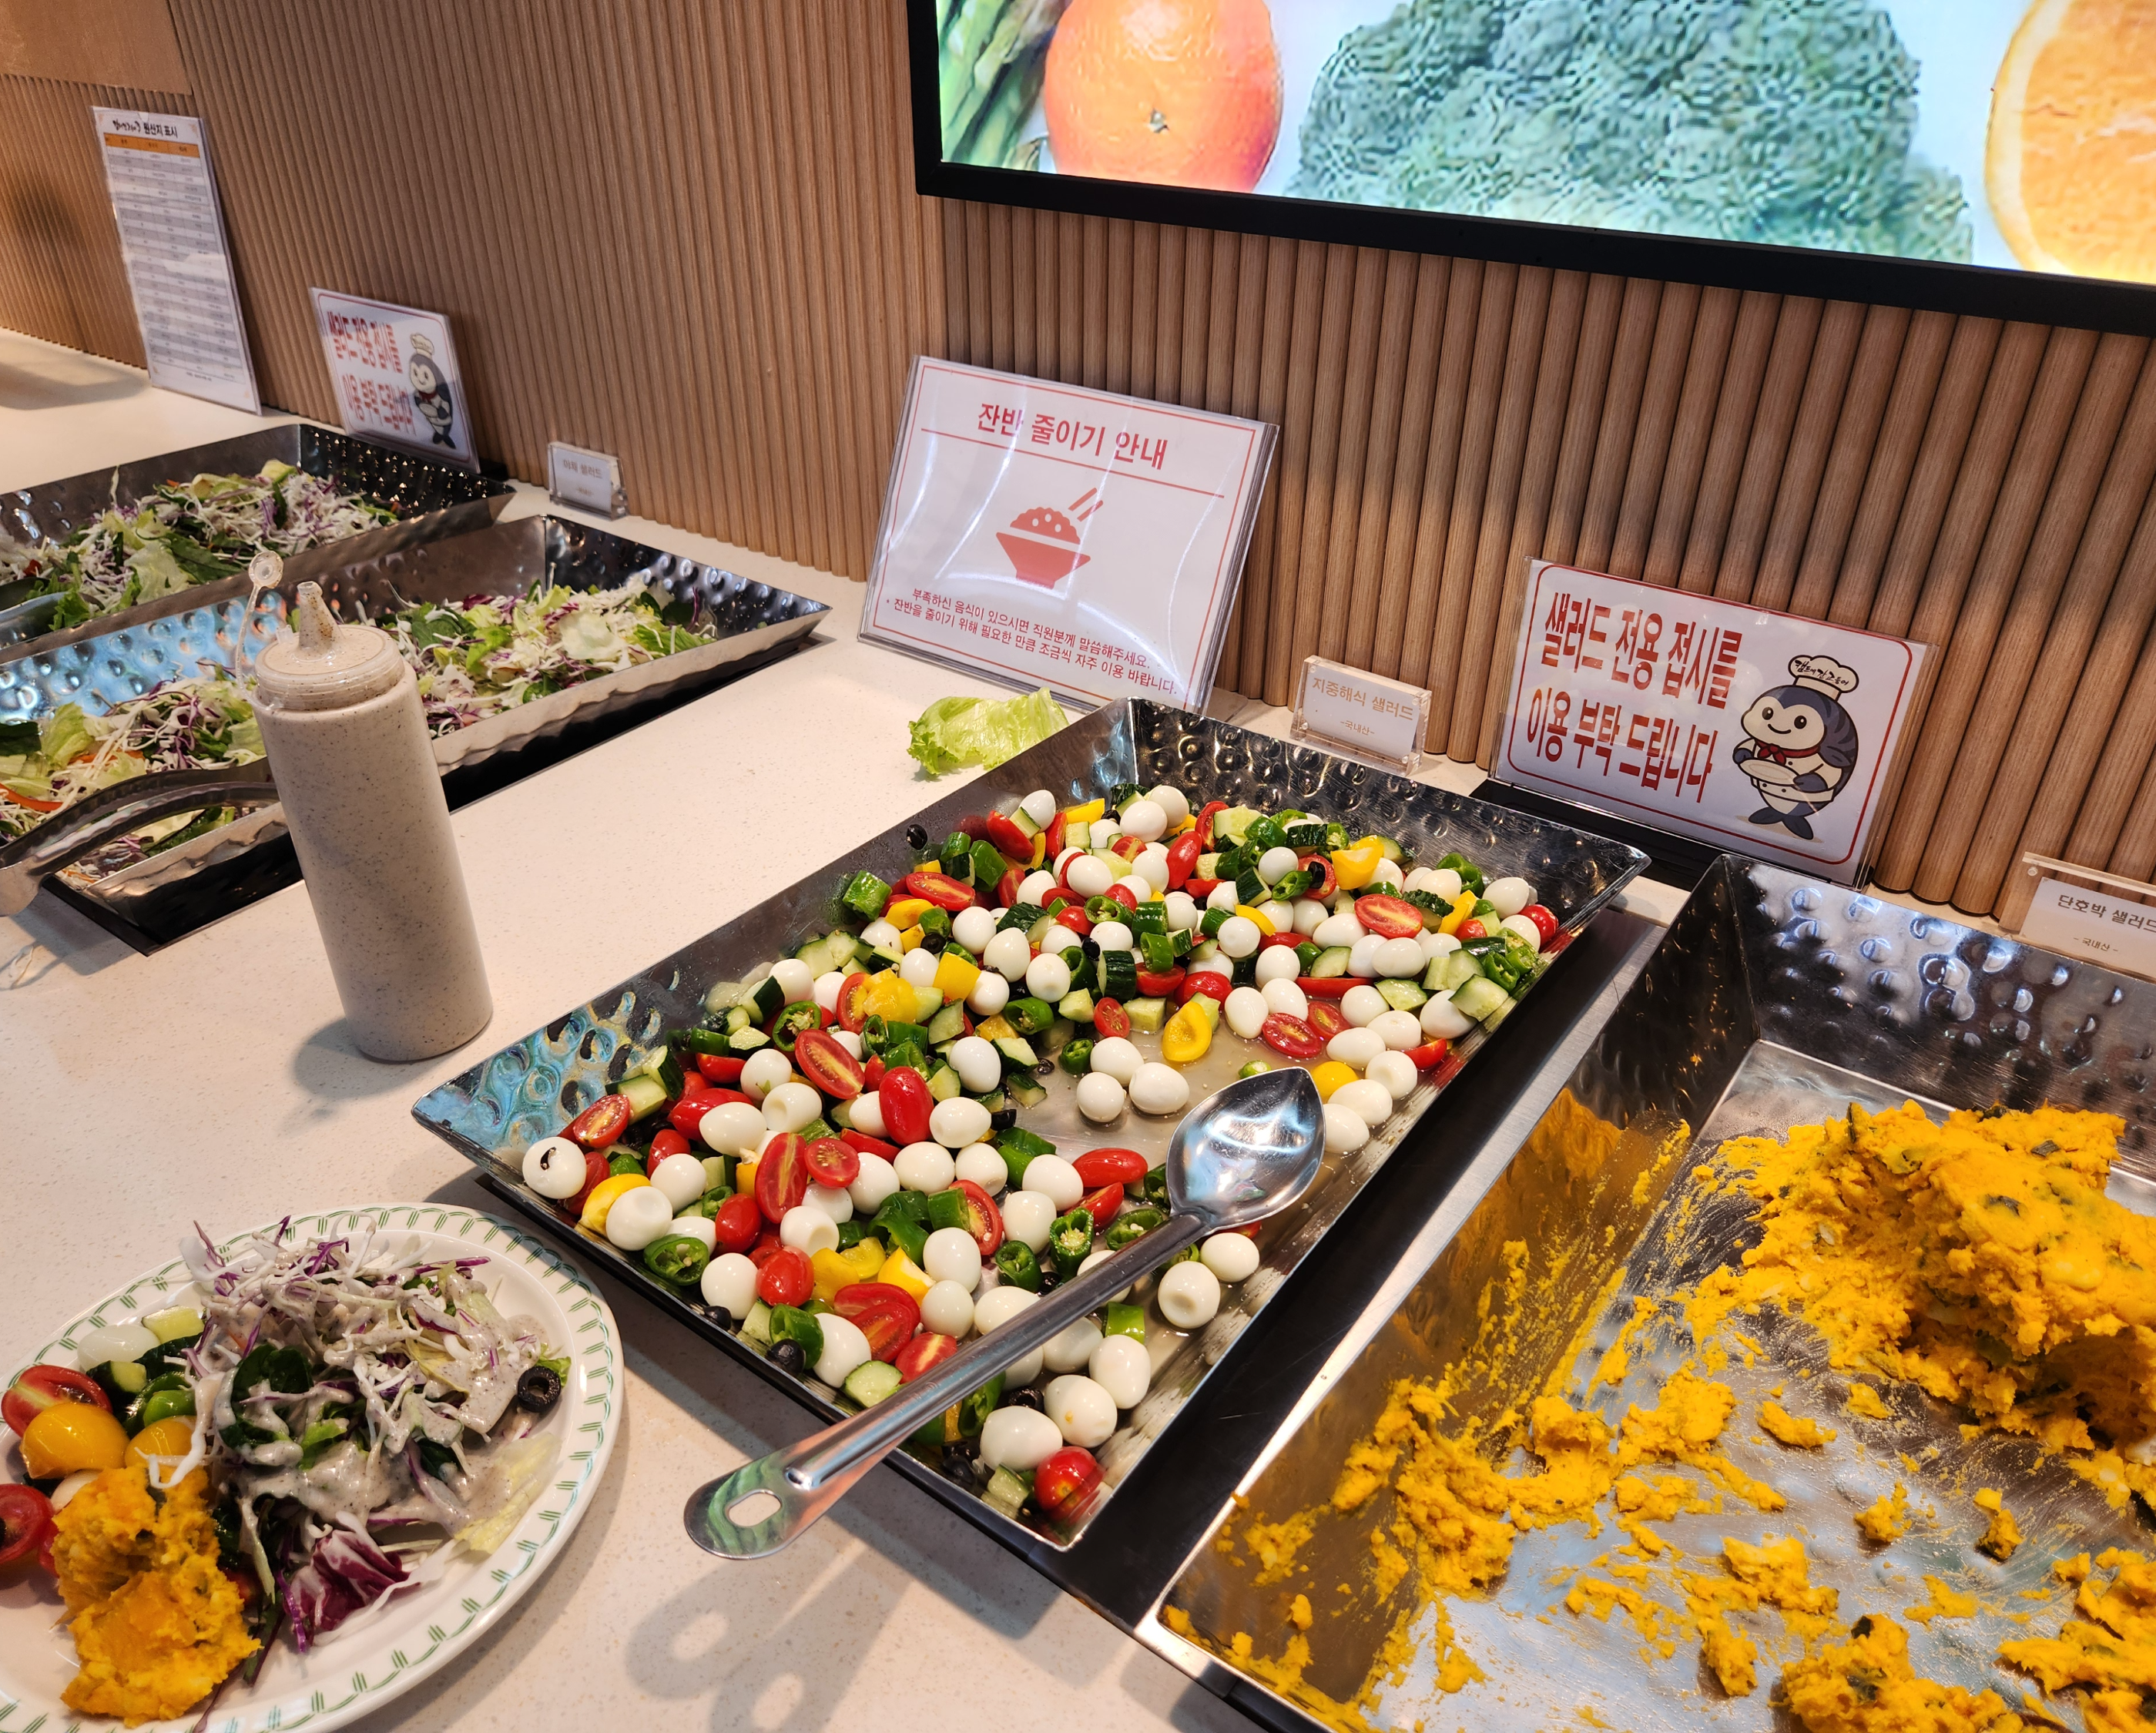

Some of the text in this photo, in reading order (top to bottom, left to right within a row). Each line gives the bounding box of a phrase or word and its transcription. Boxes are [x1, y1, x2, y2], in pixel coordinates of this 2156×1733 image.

[342, 374, 417, 437] 이용 부탁 드립니다
[977, 403, 1169, 470] 잔반 줄이기 안내
[581, 464, 602, 479] 샐러드
[894, 598, 1178, 695] 잔반을 줄이기 위해 필요한 만큼 조금씩 자주 이용 바랍니다.
[912, 588, 1150, 669] 부족하신 음식이 있으시면 직원분께 말씀해주세요.
[1541, 592, 1743, 710] 샐러드 전용 접시를
[1312, 676, 1414, 721] 지중해식 샐러드
[1527, 687, 1718, 803] 이용 부탁 드립니다
[2057, 893, 2107, 918] 단호박
